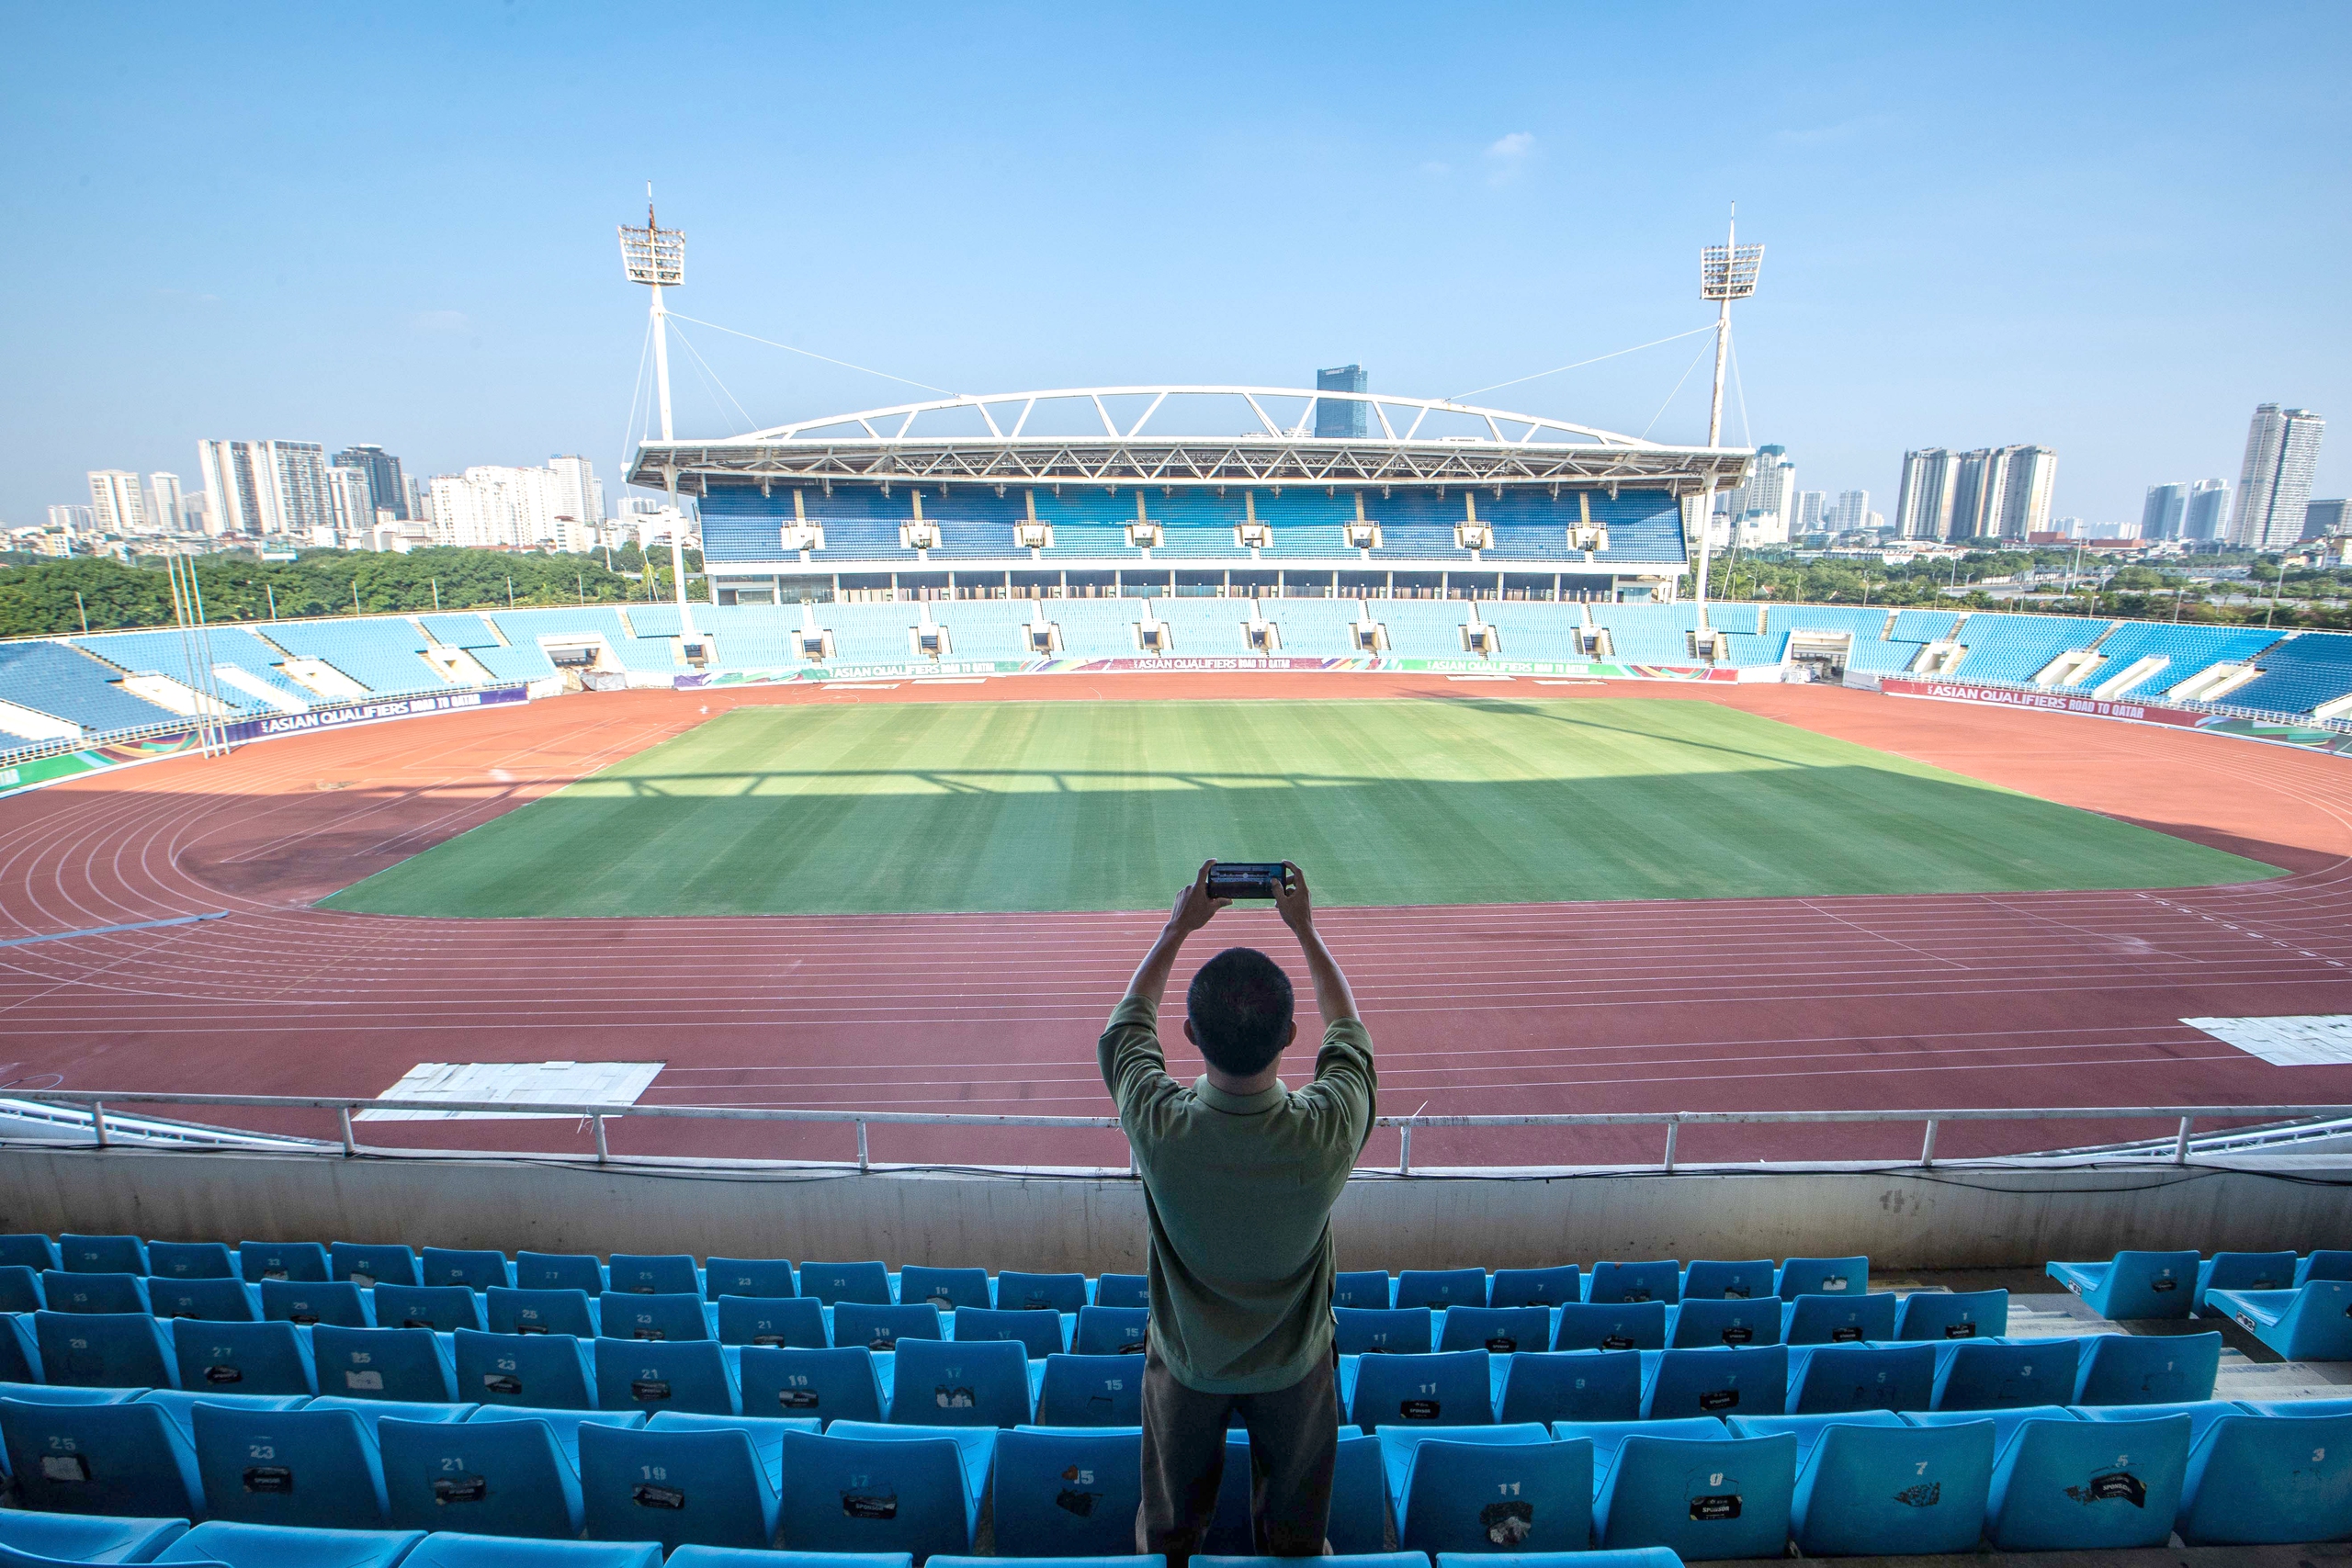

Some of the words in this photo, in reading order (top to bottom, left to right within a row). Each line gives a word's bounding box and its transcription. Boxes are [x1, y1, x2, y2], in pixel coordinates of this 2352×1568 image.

[1138, 659, 1172, 669] ASIAN
[1174, 659, 1238, 669] QUALIFIERS
[1431, 660, 1466, 671] ASIAN
[1468, 661, 1532, 672] QUALIFIERS
[834, 667, 872, 678] ASIAN
[872, 664, 940, 677] QUALIFIERS
[1933, 685, 1978, 700] ASIAN
[1980, 689, 2066, 710] QUALIFIERS
[2068, 699, 2095, 713] ROAD
[2098, 702, 2110, 715] TO
[2111, 705, 2144, 719] QATAR
[269, 714, 320, 732] ASIAN
[320, 702, 410, 724] QUALIFIERS
[410, 698, 436, 713] ROAD
[436, 696, 450, 709] TO
[451, 694, 481, 708] QATAR
[739, 1277, 752, 1286] 23
[1636, 1278, 1644, 1286] 5
[1733, 1276, 1740, 1284] 3
[637, 1314, 652, 1324] 23
[758, 1321, 773, 1329] 21
[1614, 1324, 1623, 1332] 7
[1125, 1327, 1138, 1337] 15
[1374, 1332, 1387, 1345] 11
[212, 1347, 232, 1358] 27
[497, 1359, 516, 1371] 23
[2167, 1361, 2174, 1371] 1
[641, 1369, 659, 1380] 21
[945, 1368, 962, 1379] 17
[2021, 1365, 2032, 1377] 3
[1104, 1380, 1123, 1391] 15
[1576, 1378, 1586, 1389] 9
[1727, 1375, 1736, 1385] 7
[1419, 1382, 1437, 1395] 11
[49, 1436, 76, 1451] 25
[249, 1444, 275, 1460] 23
[2312, 1448, 2325, 1461] 3
[441, 1457, 464, 1471] 21
[2116, 1454, 2129, 1468] 5
[1916, 1461, 1928, 1475] 7
[1498, 1481, 1521, 1496] 11
